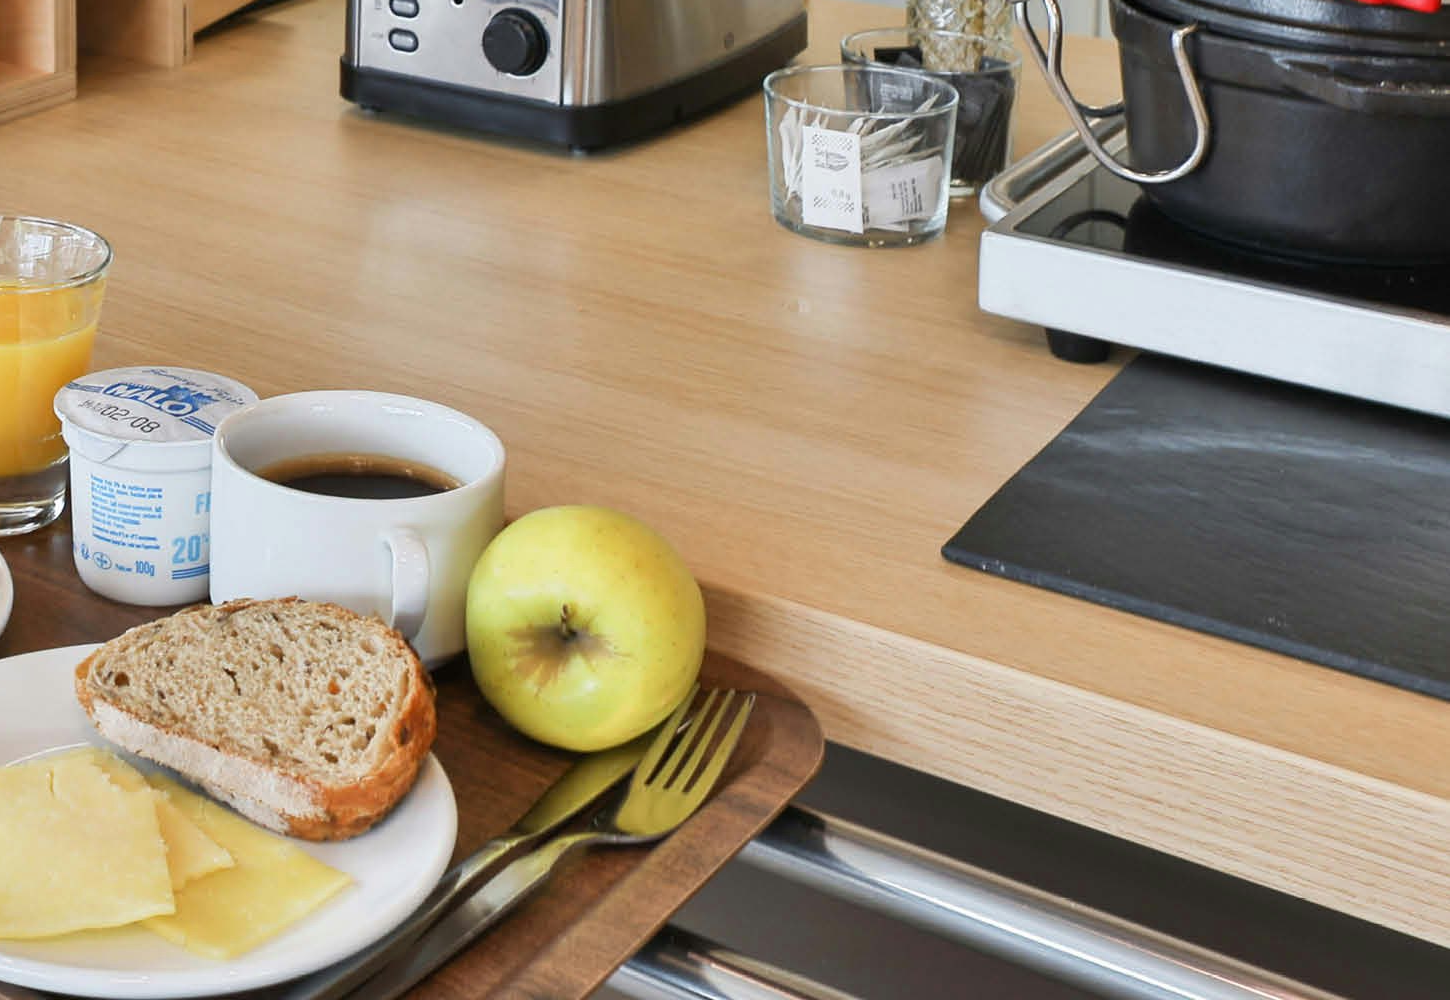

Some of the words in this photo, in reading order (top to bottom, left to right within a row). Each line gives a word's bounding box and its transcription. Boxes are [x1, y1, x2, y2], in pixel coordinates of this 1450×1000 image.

[103, 383, 198, 417] MALO
[100, 405, 160, 433] 02/08
[135, 560, 155, 577] 100g
